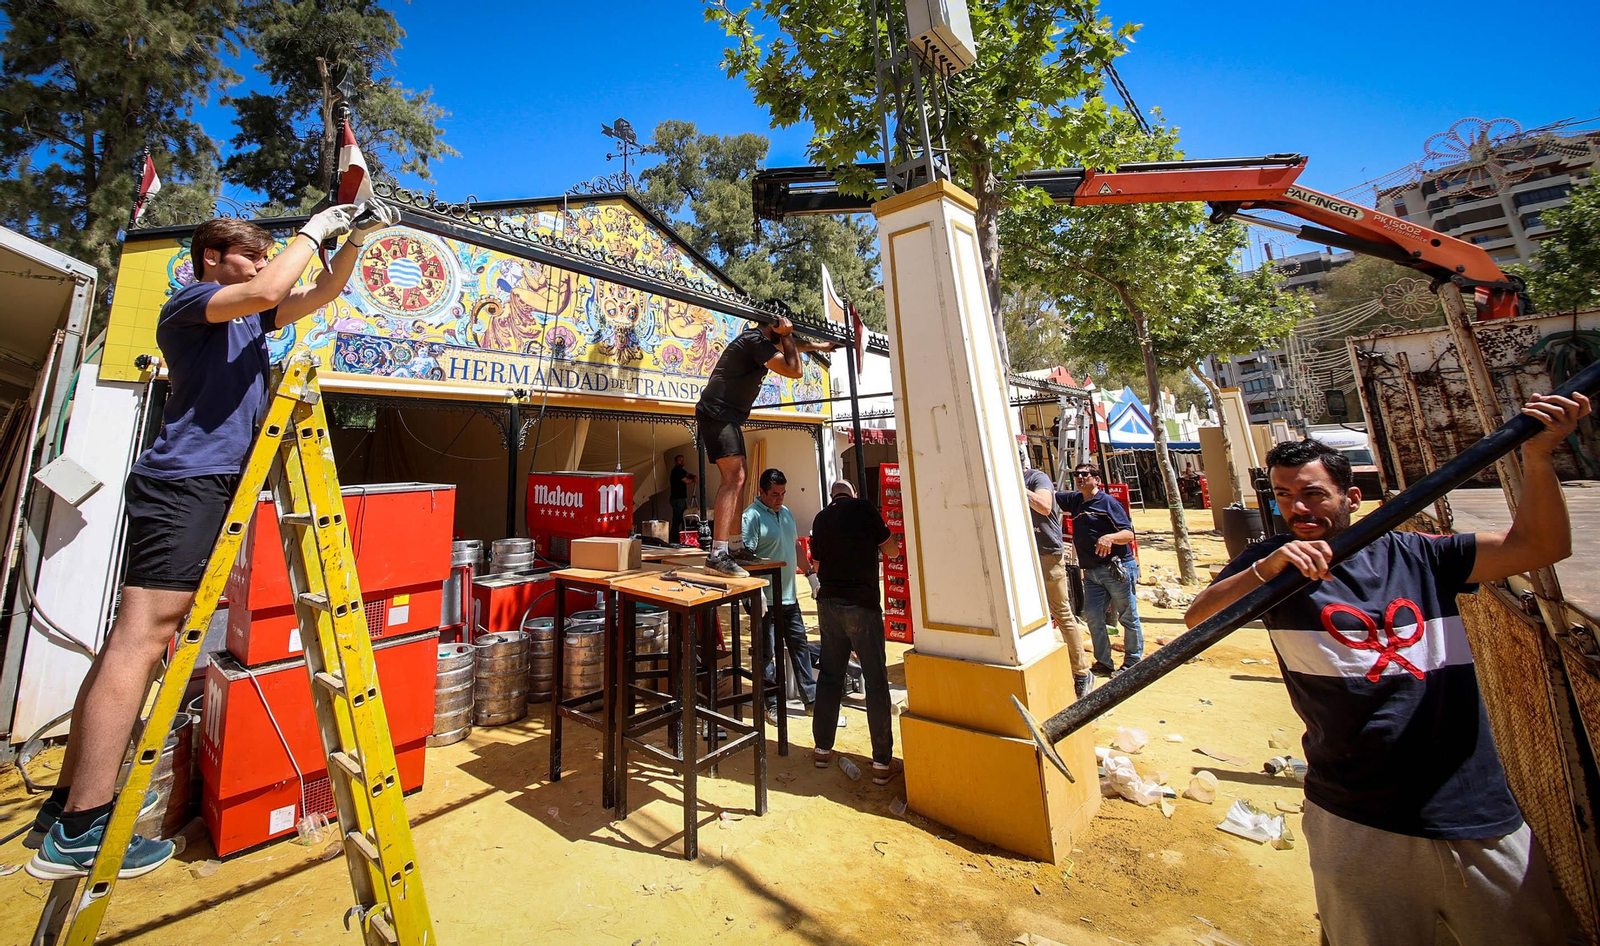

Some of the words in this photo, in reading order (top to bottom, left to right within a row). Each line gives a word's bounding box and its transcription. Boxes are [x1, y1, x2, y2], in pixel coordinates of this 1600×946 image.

[1284, 186, 1359, 219] PALFINGER
[1373, 213, 1387, 225] PK
[1388, 220, 1422, 236] 15002
[1383, 224, 1429, 243] Performance
[448, 357, 609, 392] HERMANDAD
[611, 378, 632, 391] DEL
[534, 484, 584, 509] Mahou
